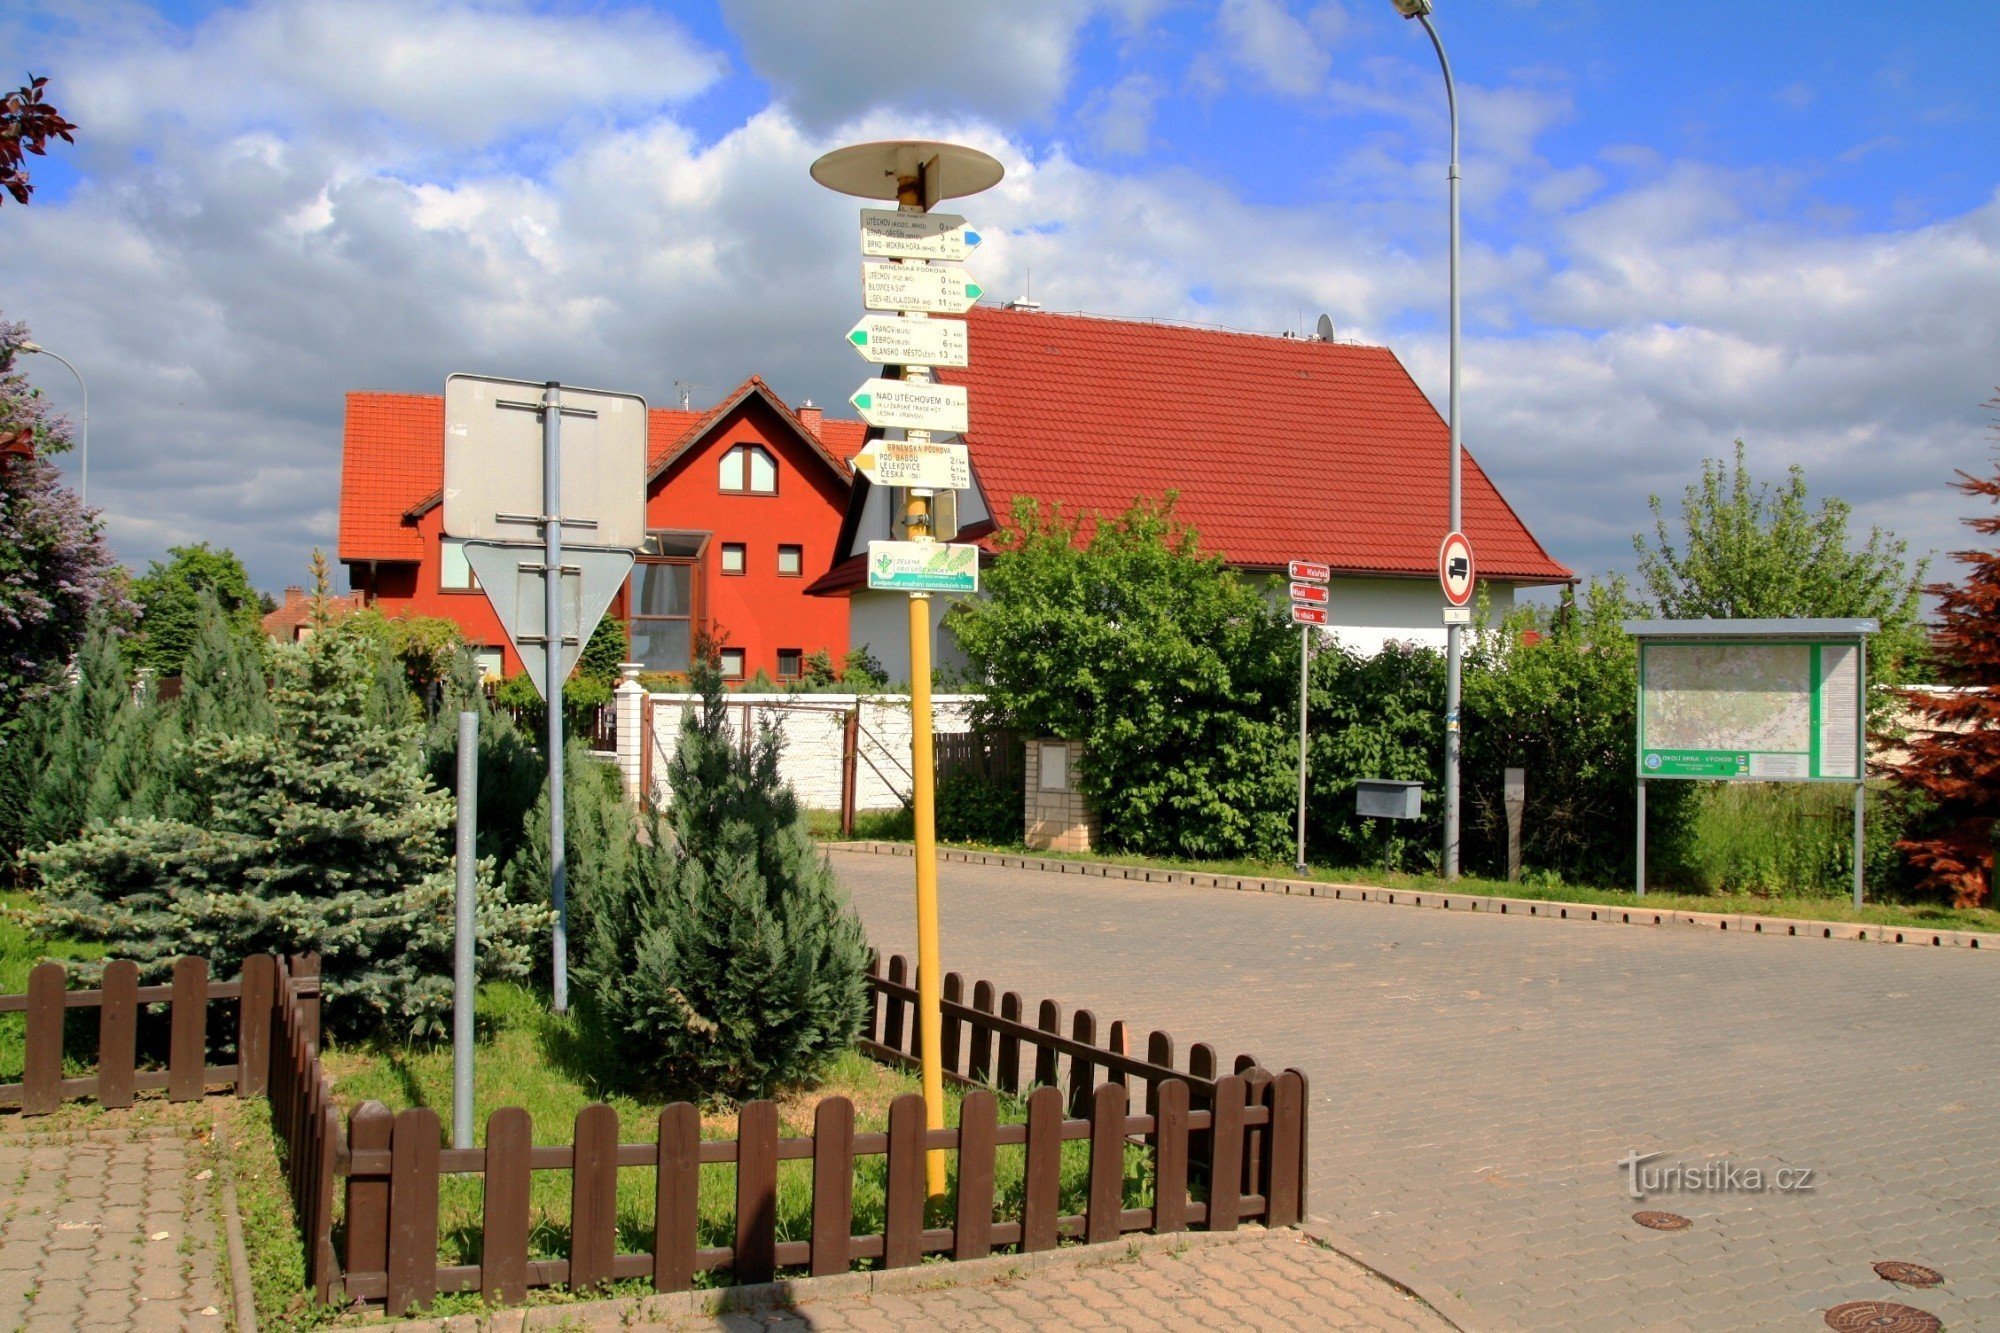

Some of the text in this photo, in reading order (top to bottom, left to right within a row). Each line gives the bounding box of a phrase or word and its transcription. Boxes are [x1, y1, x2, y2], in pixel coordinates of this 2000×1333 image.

[872, 347, 898, 356] BLANSKO
[876, 392, 892, 401] NAD
[924, 445, 951, 454] PODKOVA
[896, 454, 918, 462] BABOU
[880, 462, 921, 471] LELEKOVICE
